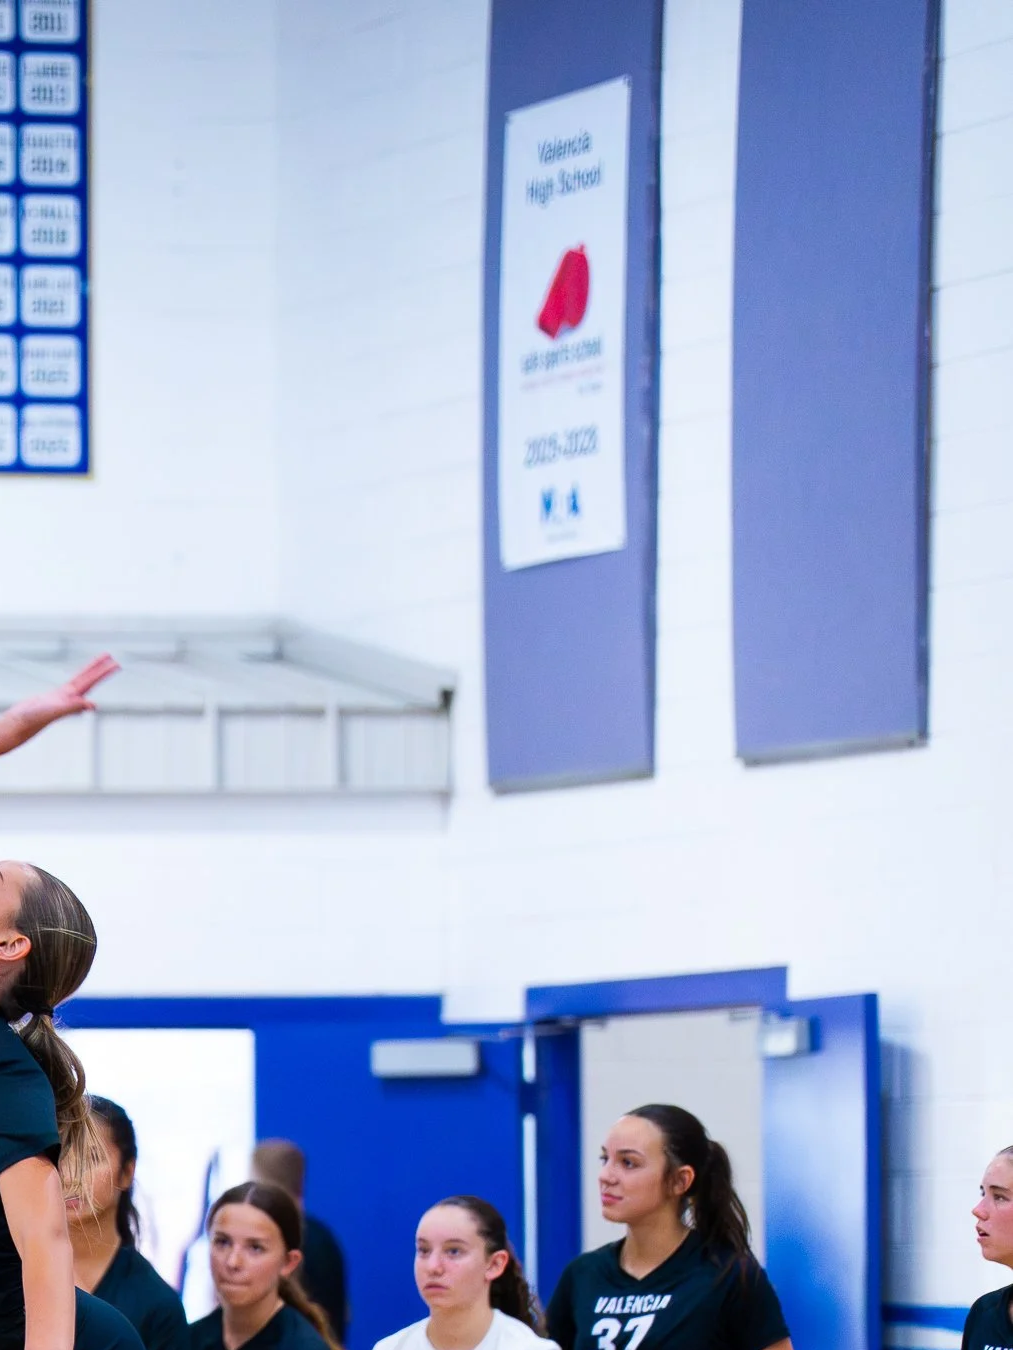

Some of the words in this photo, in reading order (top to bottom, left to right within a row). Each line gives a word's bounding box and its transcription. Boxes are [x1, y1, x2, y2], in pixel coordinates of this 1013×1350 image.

[538, 130, 592, 165] Valencia
[526, 176, 553, 208] High
[557, 162, 601, 196] School
[594, 1294, 672, 1315] VALENCIA
